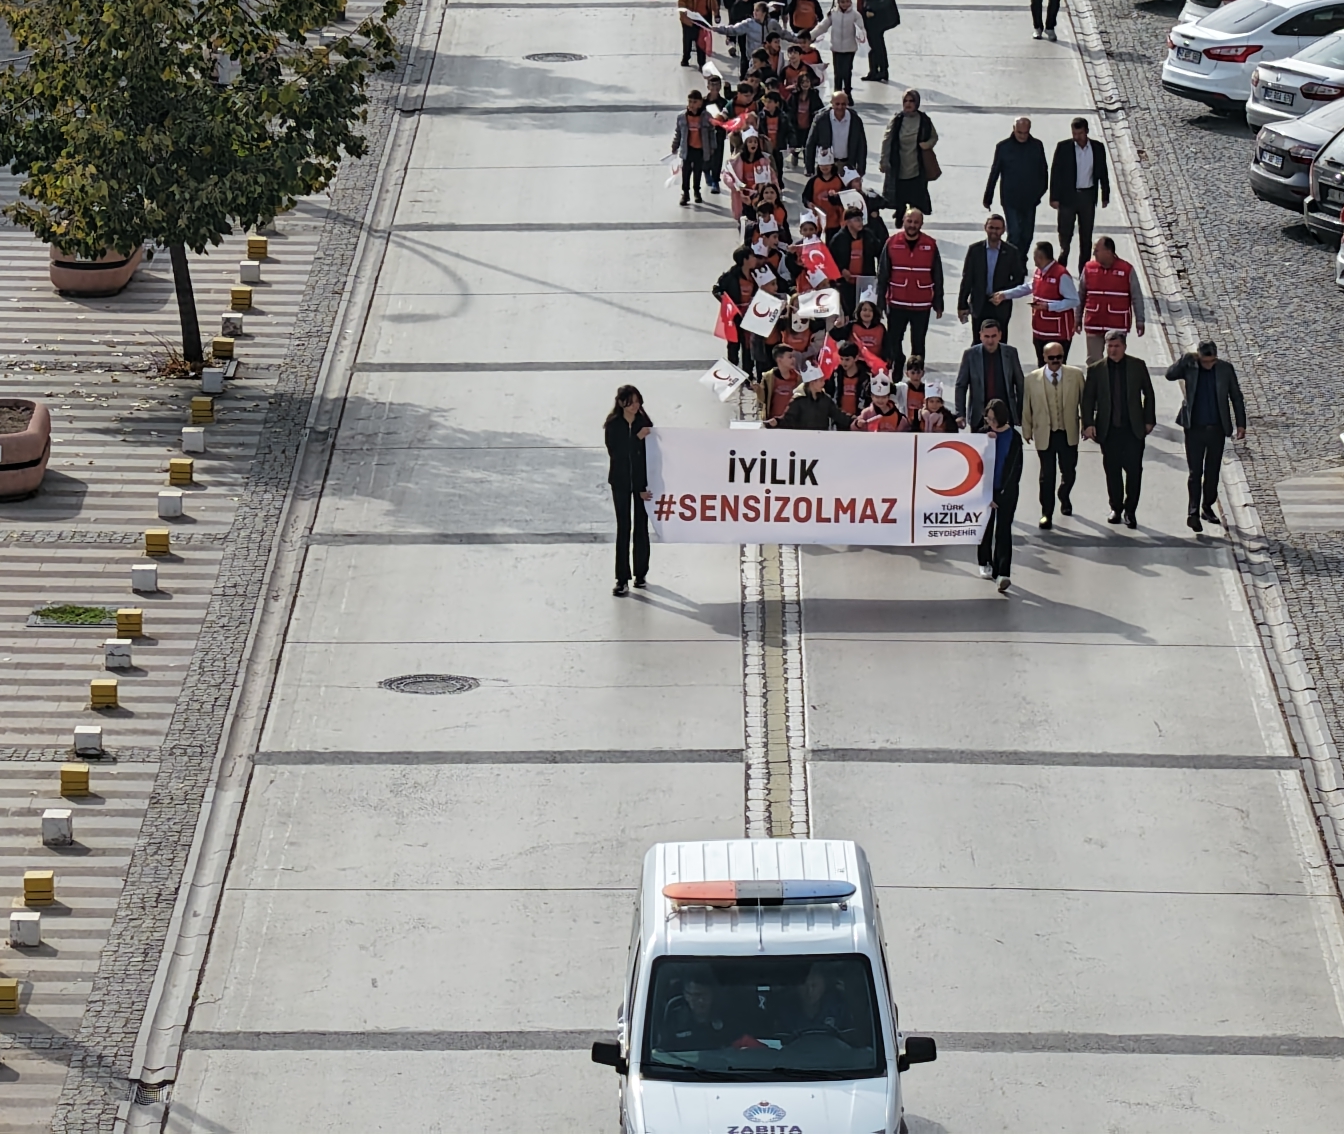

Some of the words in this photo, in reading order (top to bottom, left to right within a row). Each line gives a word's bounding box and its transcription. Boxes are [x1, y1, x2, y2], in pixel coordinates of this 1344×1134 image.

[728, 449, 819, 487] İYİLİK
[654, 488, 898, 525] #SENSİZOLMAZ
[941, 503, 965, 511] TÜRK
[923, 511, 983, 524] KIZILAY
[927, 528, 977, 538] SEYDİŞEHİR
